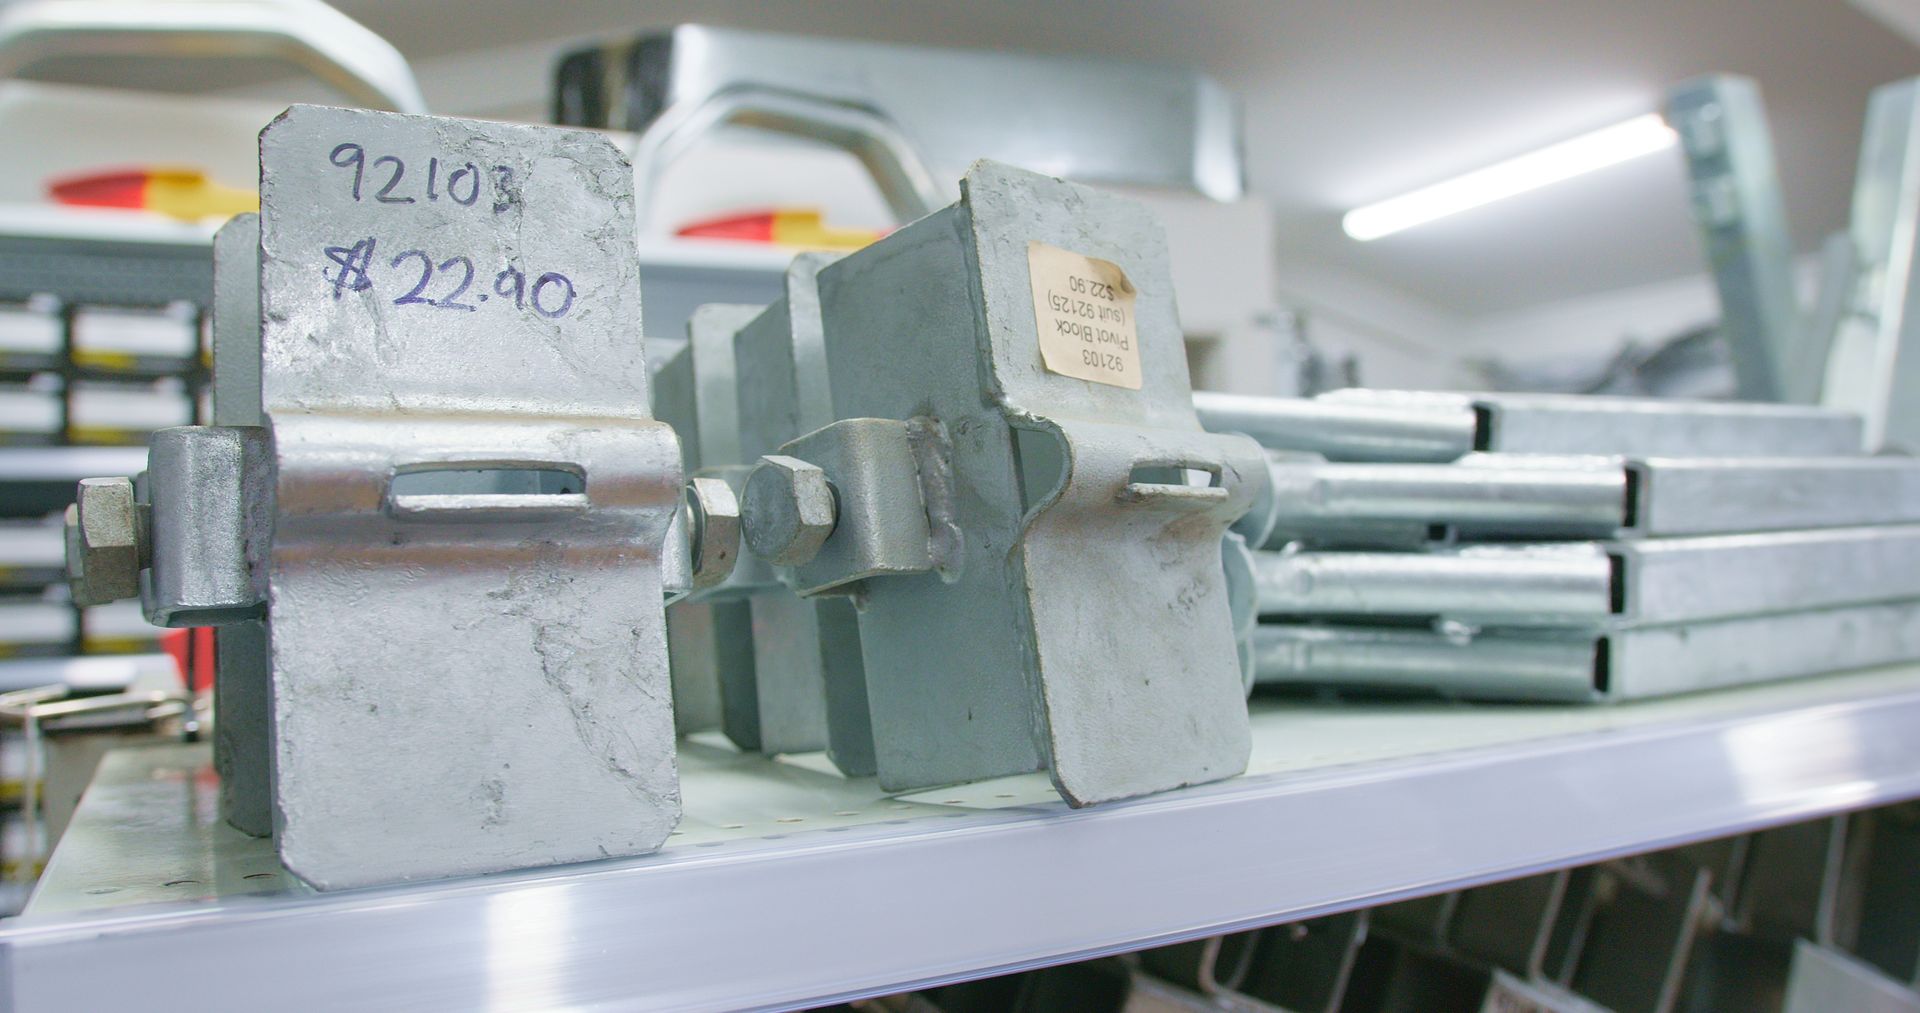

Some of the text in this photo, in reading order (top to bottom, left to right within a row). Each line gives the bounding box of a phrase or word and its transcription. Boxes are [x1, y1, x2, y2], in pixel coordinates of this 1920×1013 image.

[329, 142, 523, 215] 92103
[1069, 275, 1115, 301] $22.90
[1047, 289, 1126, 326] (suit 92125)
[1055, 318, 1129, 351] Pivot Block
[1082, 349, 1124, 372] 92103
